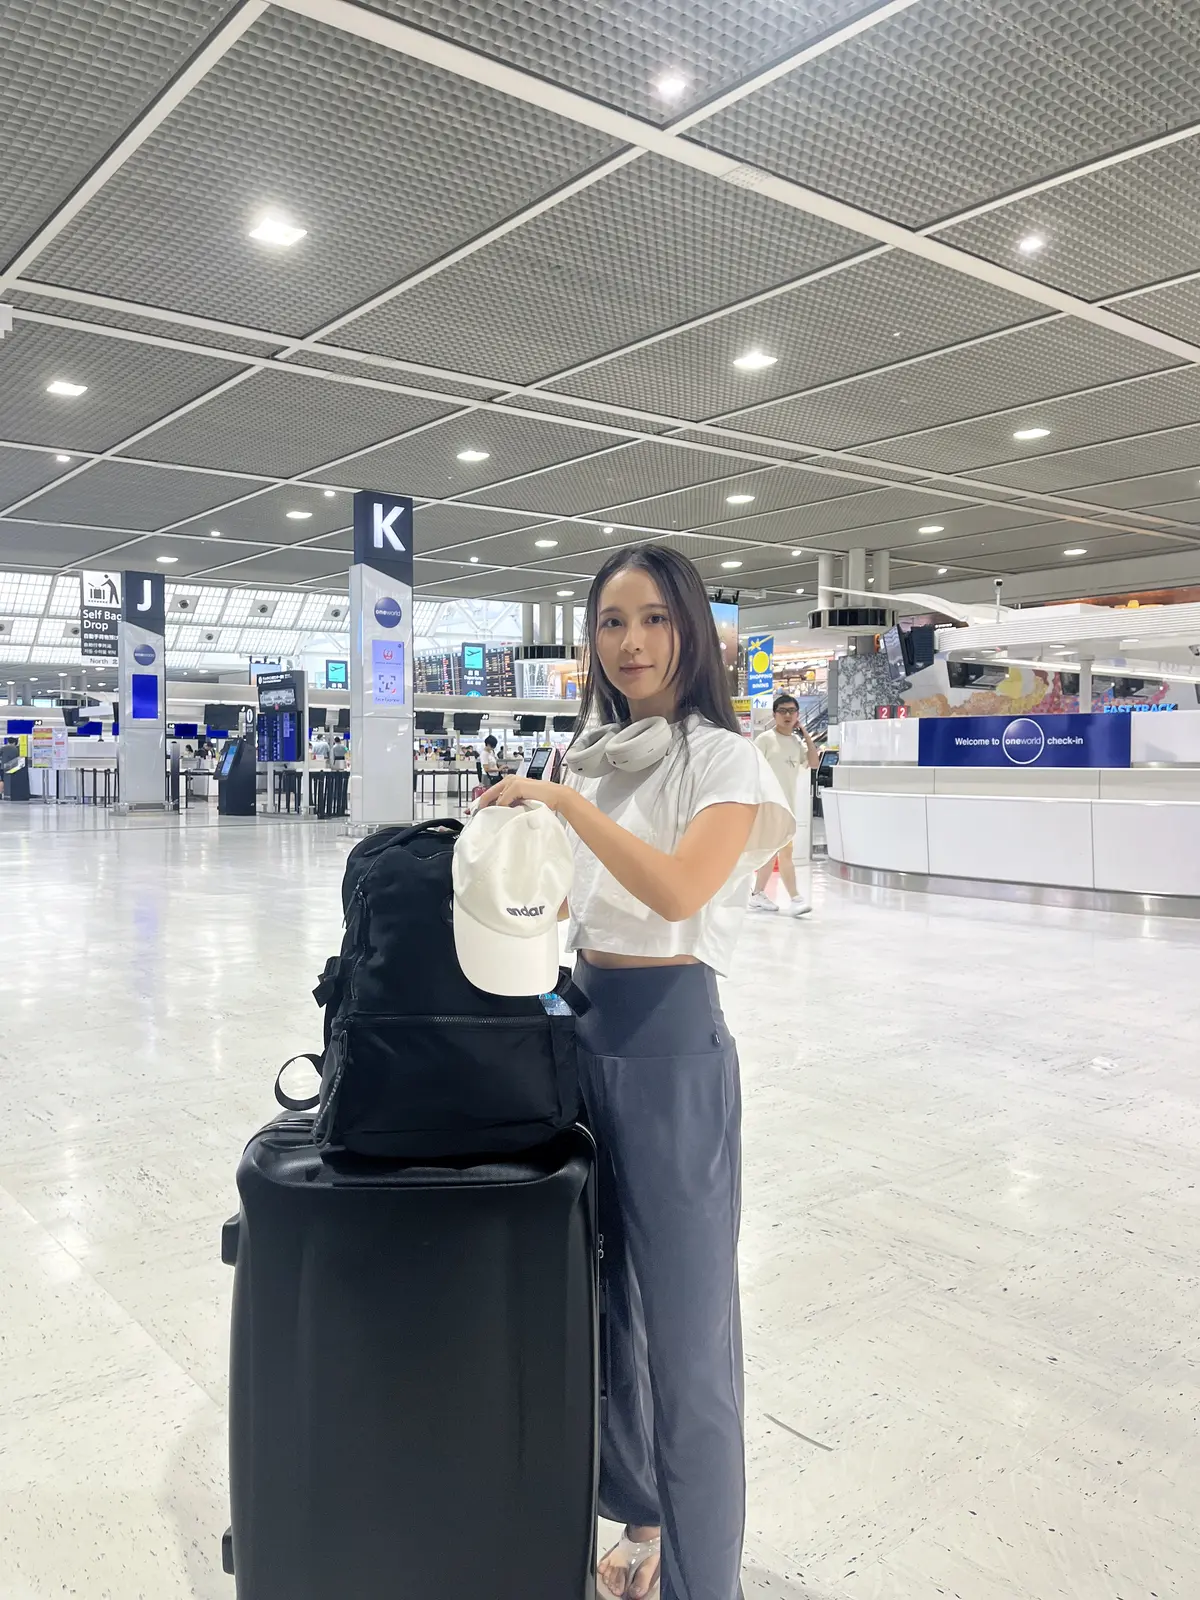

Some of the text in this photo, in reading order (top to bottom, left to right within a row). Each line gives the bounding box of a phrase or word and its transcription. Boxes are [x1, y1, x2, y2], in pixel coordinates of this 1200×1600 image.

[373, 502, 406, 551] K
[137, 579, 152, 612] J
[83, 609, 102, 619] Self
[375, 609, 401, 617] oneworld
[83, 620, 109, 632] Drop
[881, 707, 888, 719] 2
[899, 707, 906, 719] 2
[955, 736, 1084, 746] Welcome to oneworld check-in
